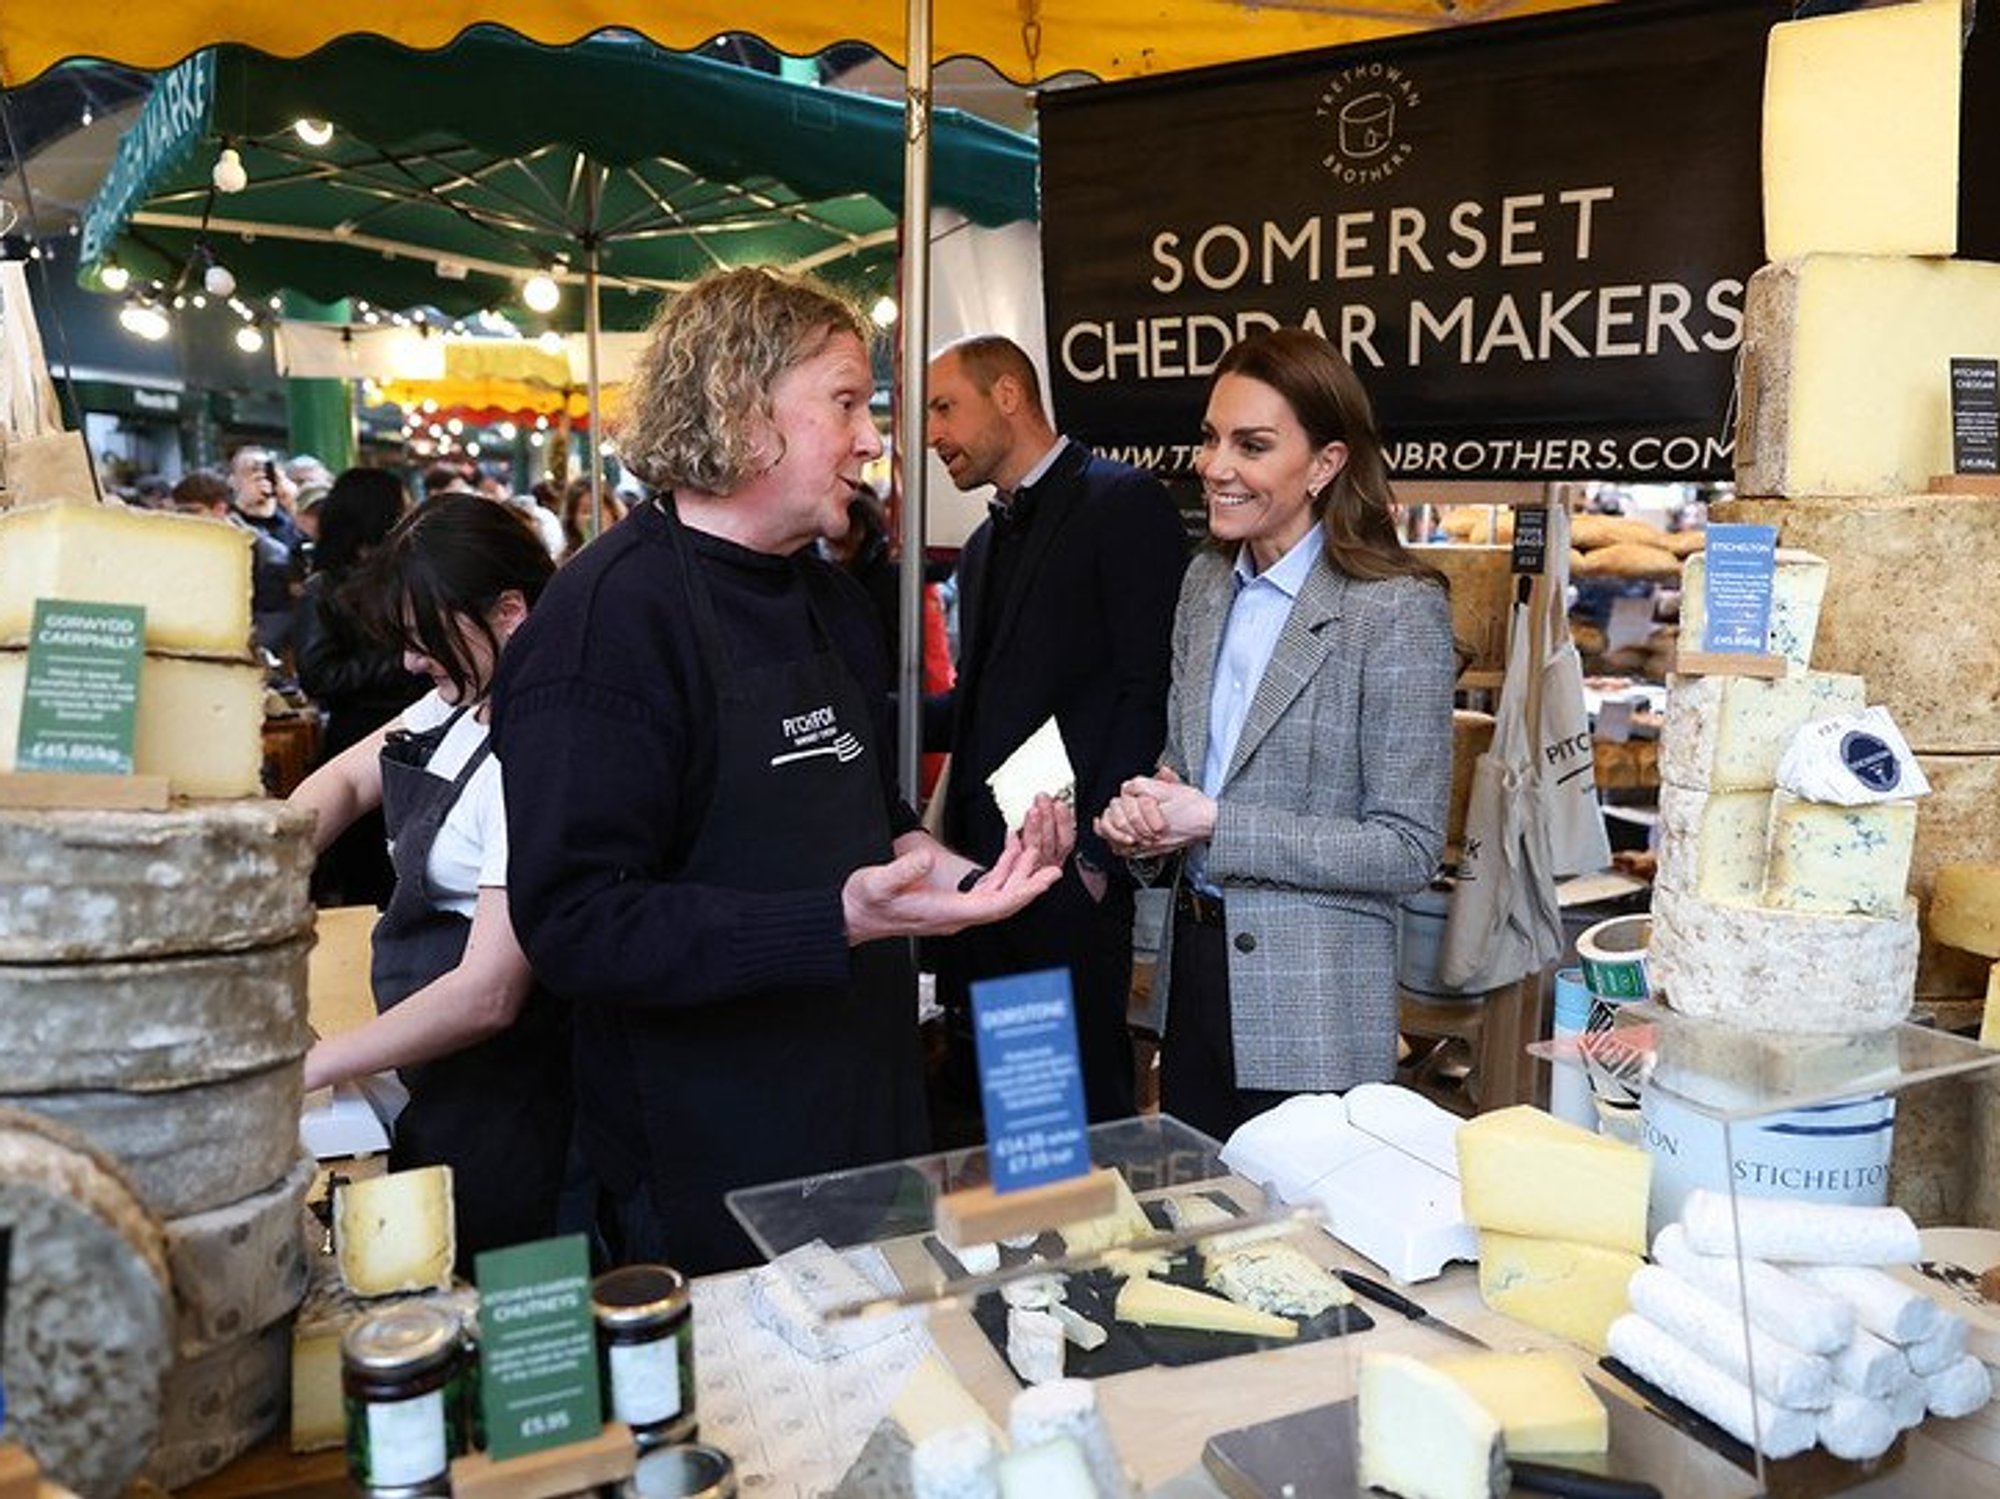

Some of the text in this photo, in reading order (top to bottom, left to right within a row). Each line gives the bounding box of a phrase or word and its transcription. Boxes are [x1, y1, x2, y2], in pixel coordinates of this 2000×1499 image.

[1315, 62, 1420, 117] TRETHOWAN
[1321, 142, 1413, 184] BROTHERS
[1151, 186, 1615, 293] SOMERSET
[1407, 278, 1746, 367] MAKERS
[1711, 542, 1771, 553] STICHELTON
[38, 630, 138, 649] CAERPHILLY
[44, 614, 135, 634] GORWYDD
[492, 1292, 580, 1323] CHUTNEYS
